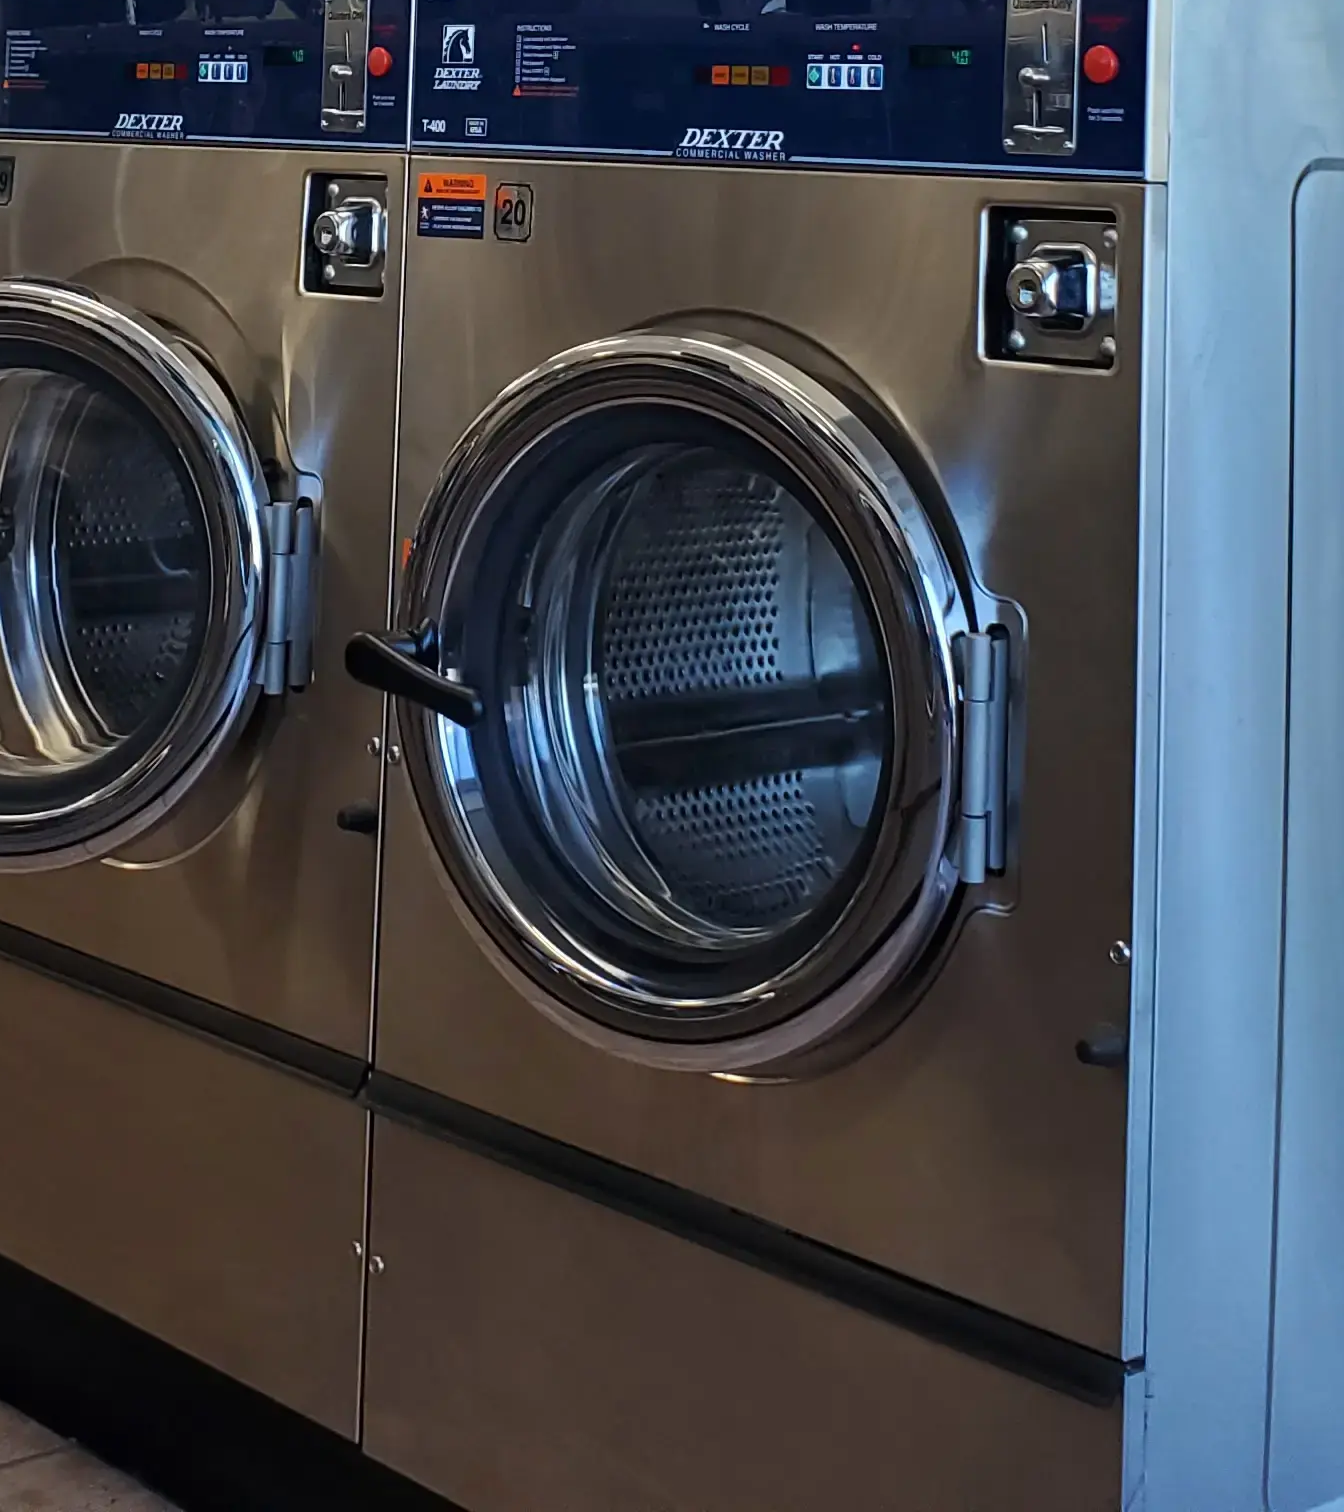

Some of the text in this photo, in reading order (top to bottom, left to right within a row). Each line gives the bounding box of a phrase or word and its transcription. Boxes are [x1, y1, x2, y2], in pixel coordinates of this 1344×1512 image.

[434, 68, 481, 79] DEXTER
[114, 113, 183, 130] DEXTER
[422, 119, 446, 133] T-400
[112, 129, 154, 139] COMMERCIAL
[679, 128, 784, 150] DEXTER
[676, 148, 786, 161] COMMERCIAL WASHER
[501, 199, 526, 225] 20
